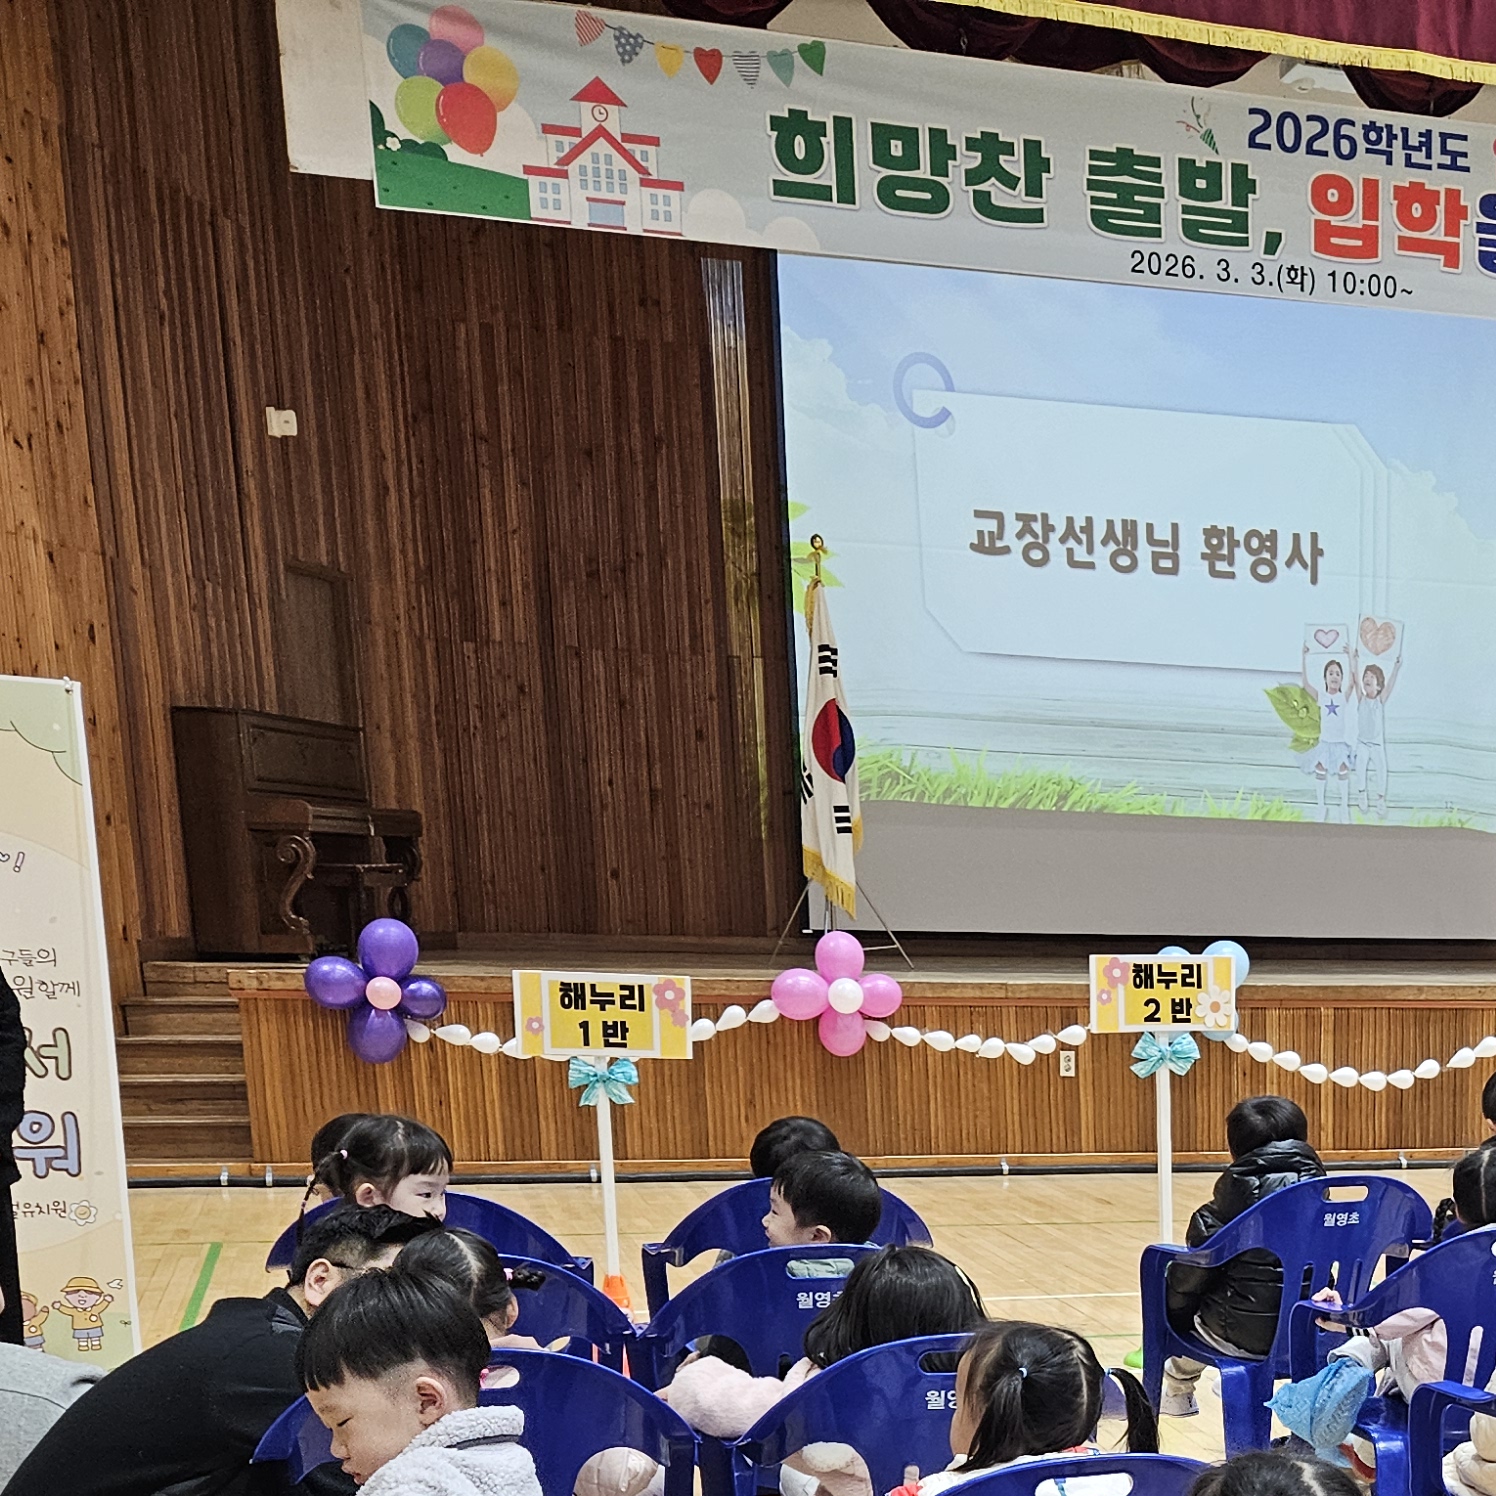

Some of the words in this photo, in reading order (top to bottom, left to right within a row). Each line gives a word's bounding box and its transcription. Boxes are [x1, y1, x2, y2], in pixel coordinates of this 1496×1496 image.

[1246, 108, 1471, 173] 2026학년도
[770, 109, 1051, 223] 희망찬
[1086, 146, 1284, 257] 출발,
[1327, 270, 1413, 300] 10:00~
[969, 508, 1182, 577] 교장선생님
[1200, 524, 1325, 586] 환영사
[1132, 963, 1203, 990] 해누리
[558, 981, 645, 1012] 해누리
[1323, 1211, 1360, 1227] 월영초
